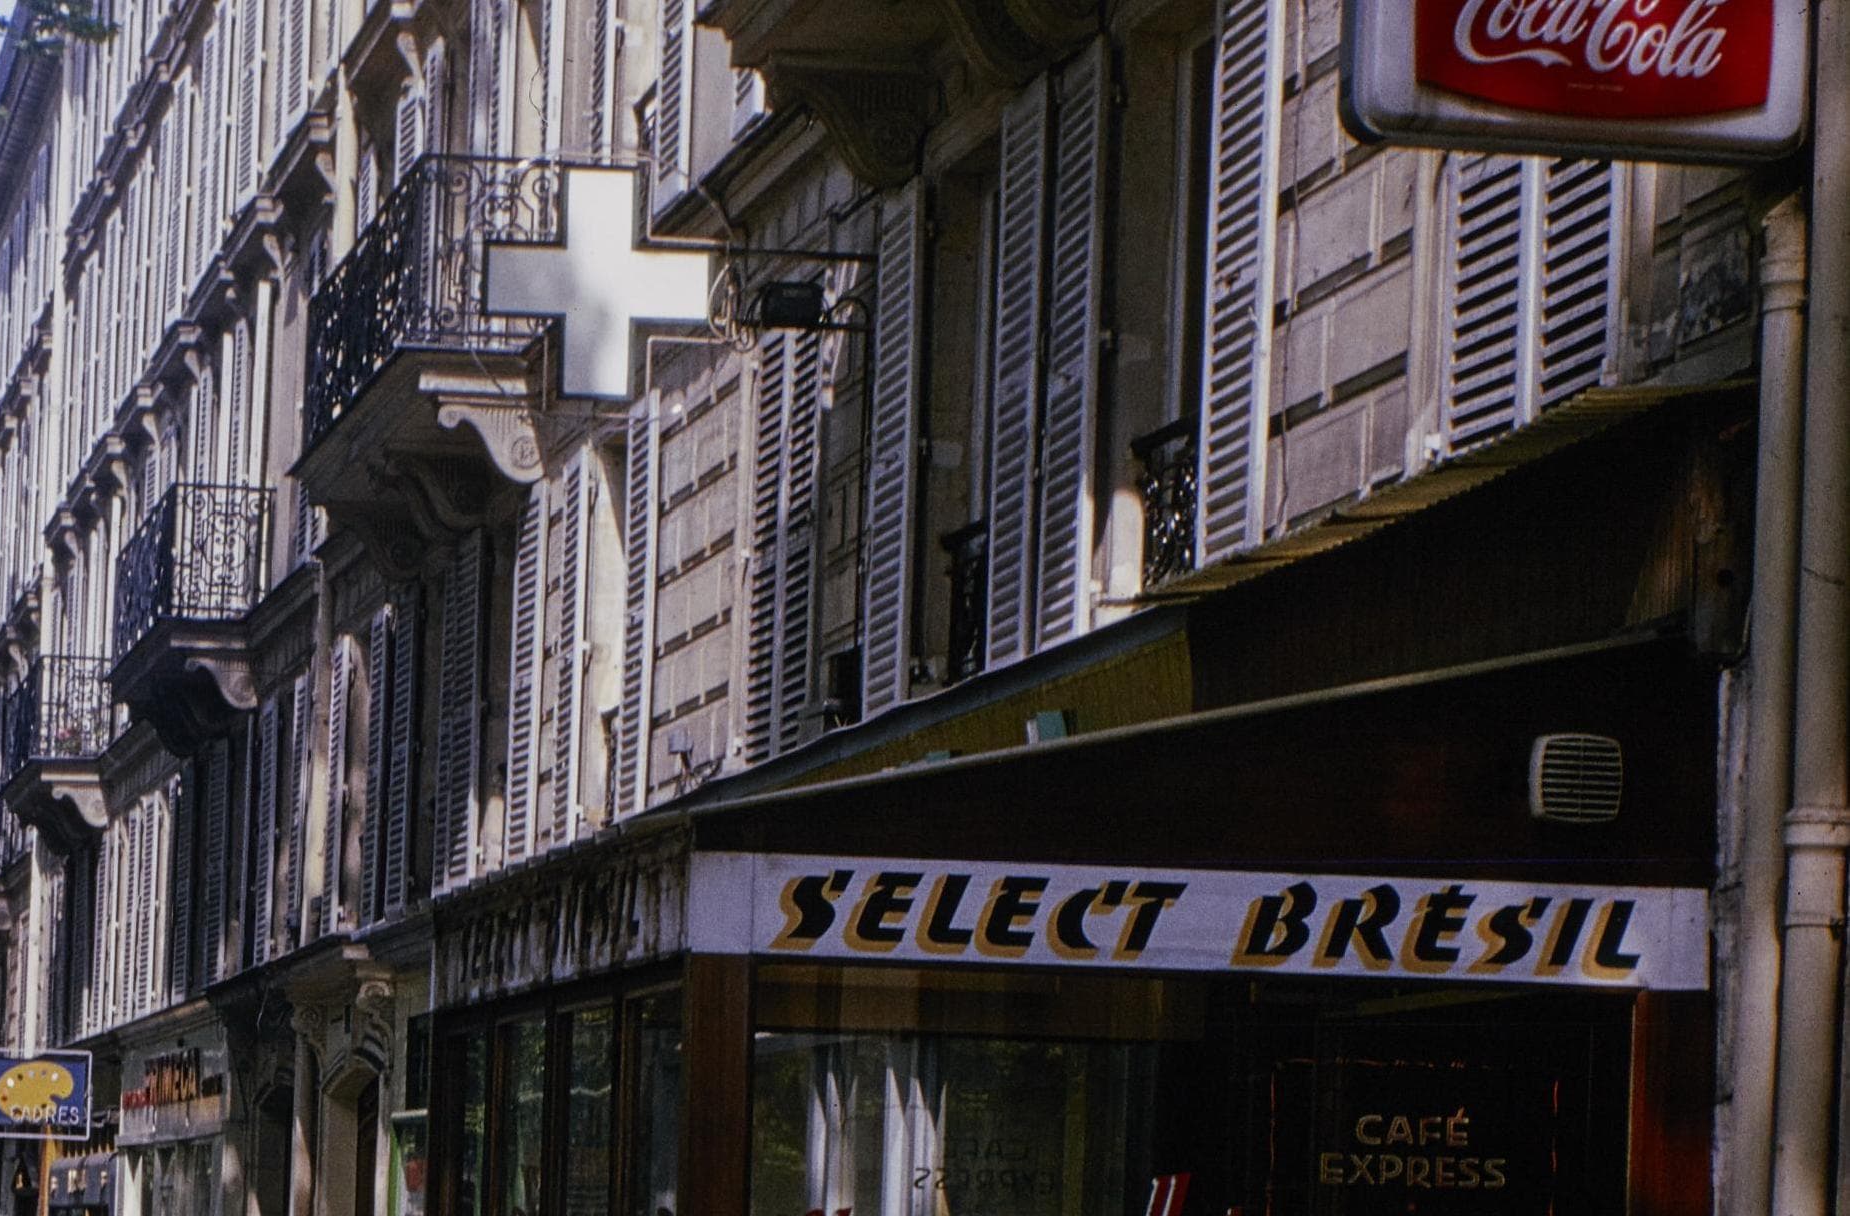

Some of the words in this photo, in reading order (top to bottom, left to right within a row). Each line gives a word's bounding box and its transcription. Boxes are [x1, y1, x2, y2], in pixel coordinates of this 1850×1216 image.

[770, 869, 1189, 961] SELECT
[1230, 881, 1641, 980] BRÉSIL
[11, 1105, 79, 1125] CADRES
[1355, 1104, 1472, 1147] CAFÉ
[1318, 1151, 1508, 1190] EXPRESS
